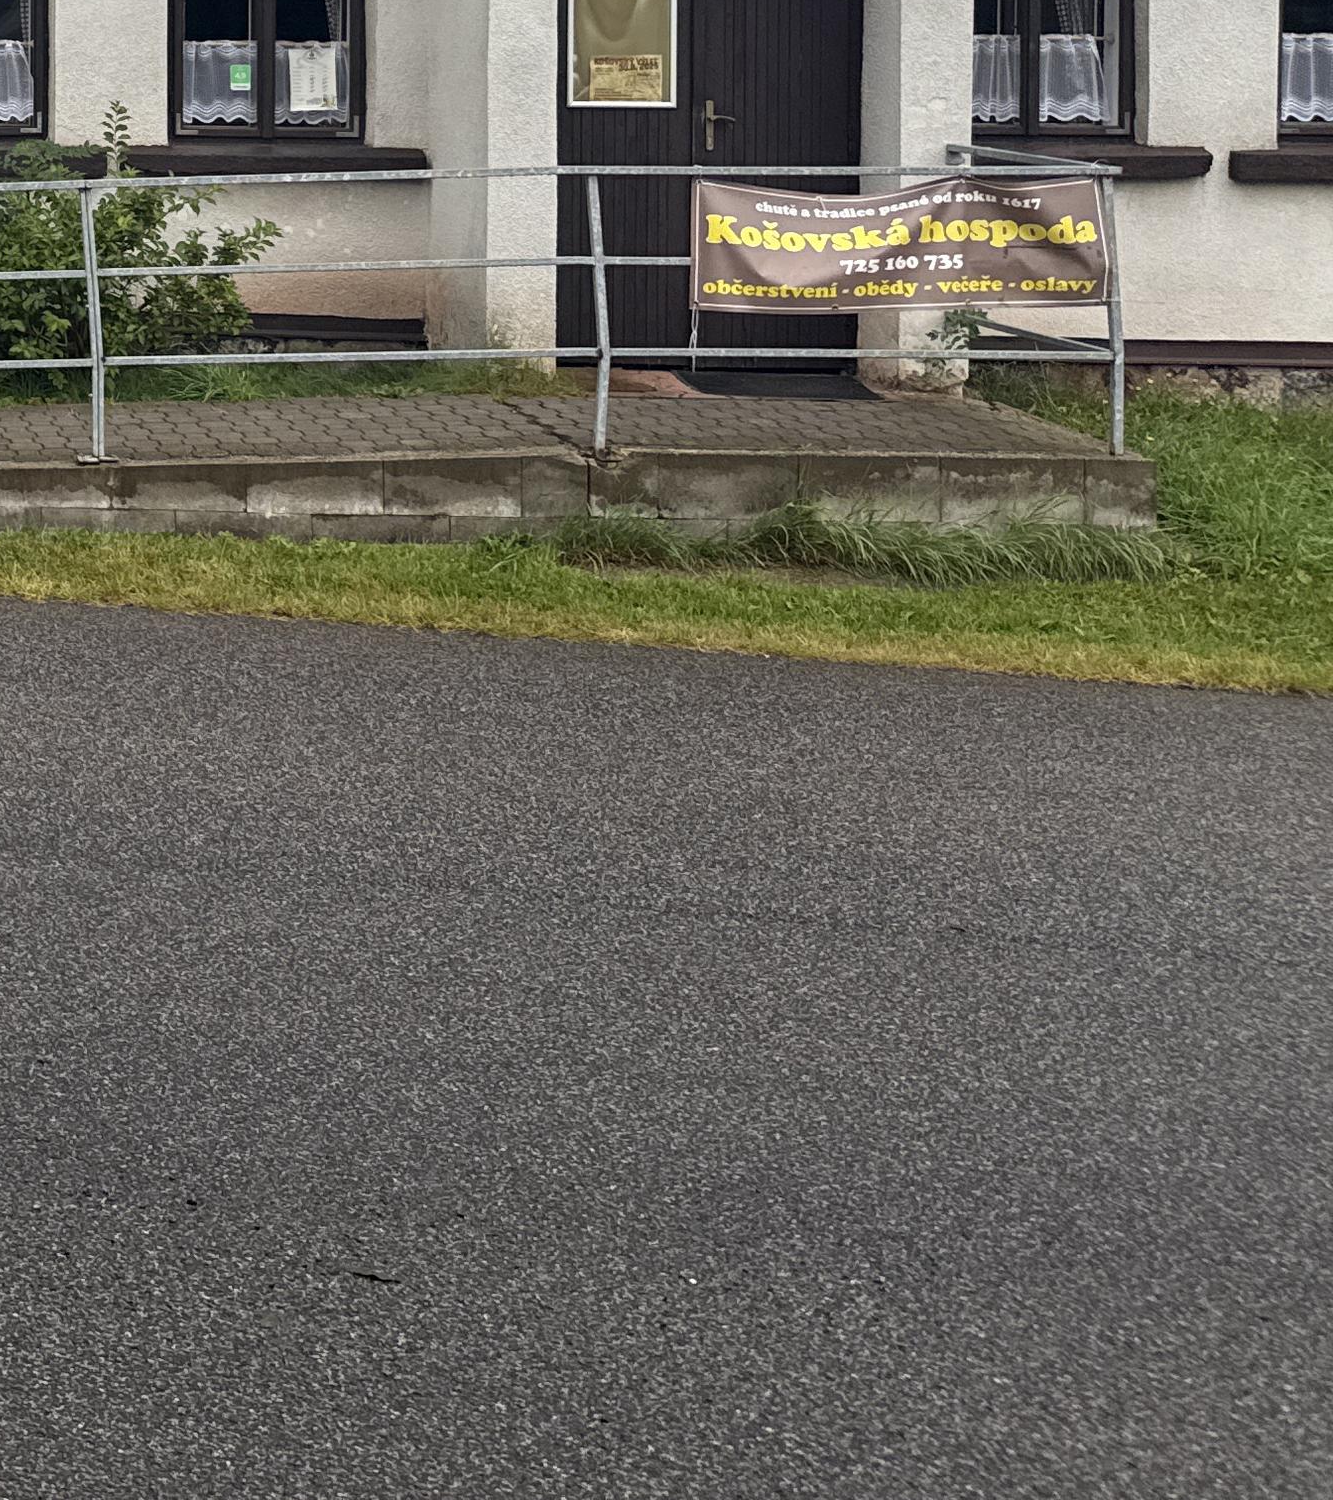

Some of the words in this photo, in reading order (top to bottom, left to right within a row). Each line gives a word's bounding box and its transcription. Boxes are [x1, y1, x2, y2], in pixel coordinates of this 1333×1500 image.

[755, 201, 798, 217] chutě
[801, 208, 811, 218] a
[814, 207, 875, 219] tradice
[878, 197, 929, 216] psané
[932, 190, 952, 204] od
[955, 189, 997, 204] roku
[1002, 197, 1041, 210] 1617
[706, 214, 911, 252] Košovská
[919, 215, 1098, 248] hospoda
[840, 258, 880, 275] 725
[885, 255, 919, 271] 160
[923, 253, 964, 271] 735
[703, 279, 838, 299] občerstvení
[854, 279, 918, 298] obědy
[936, 275, 1004, 293] večeře
[1020, 276, 1097, 294] oslavy
